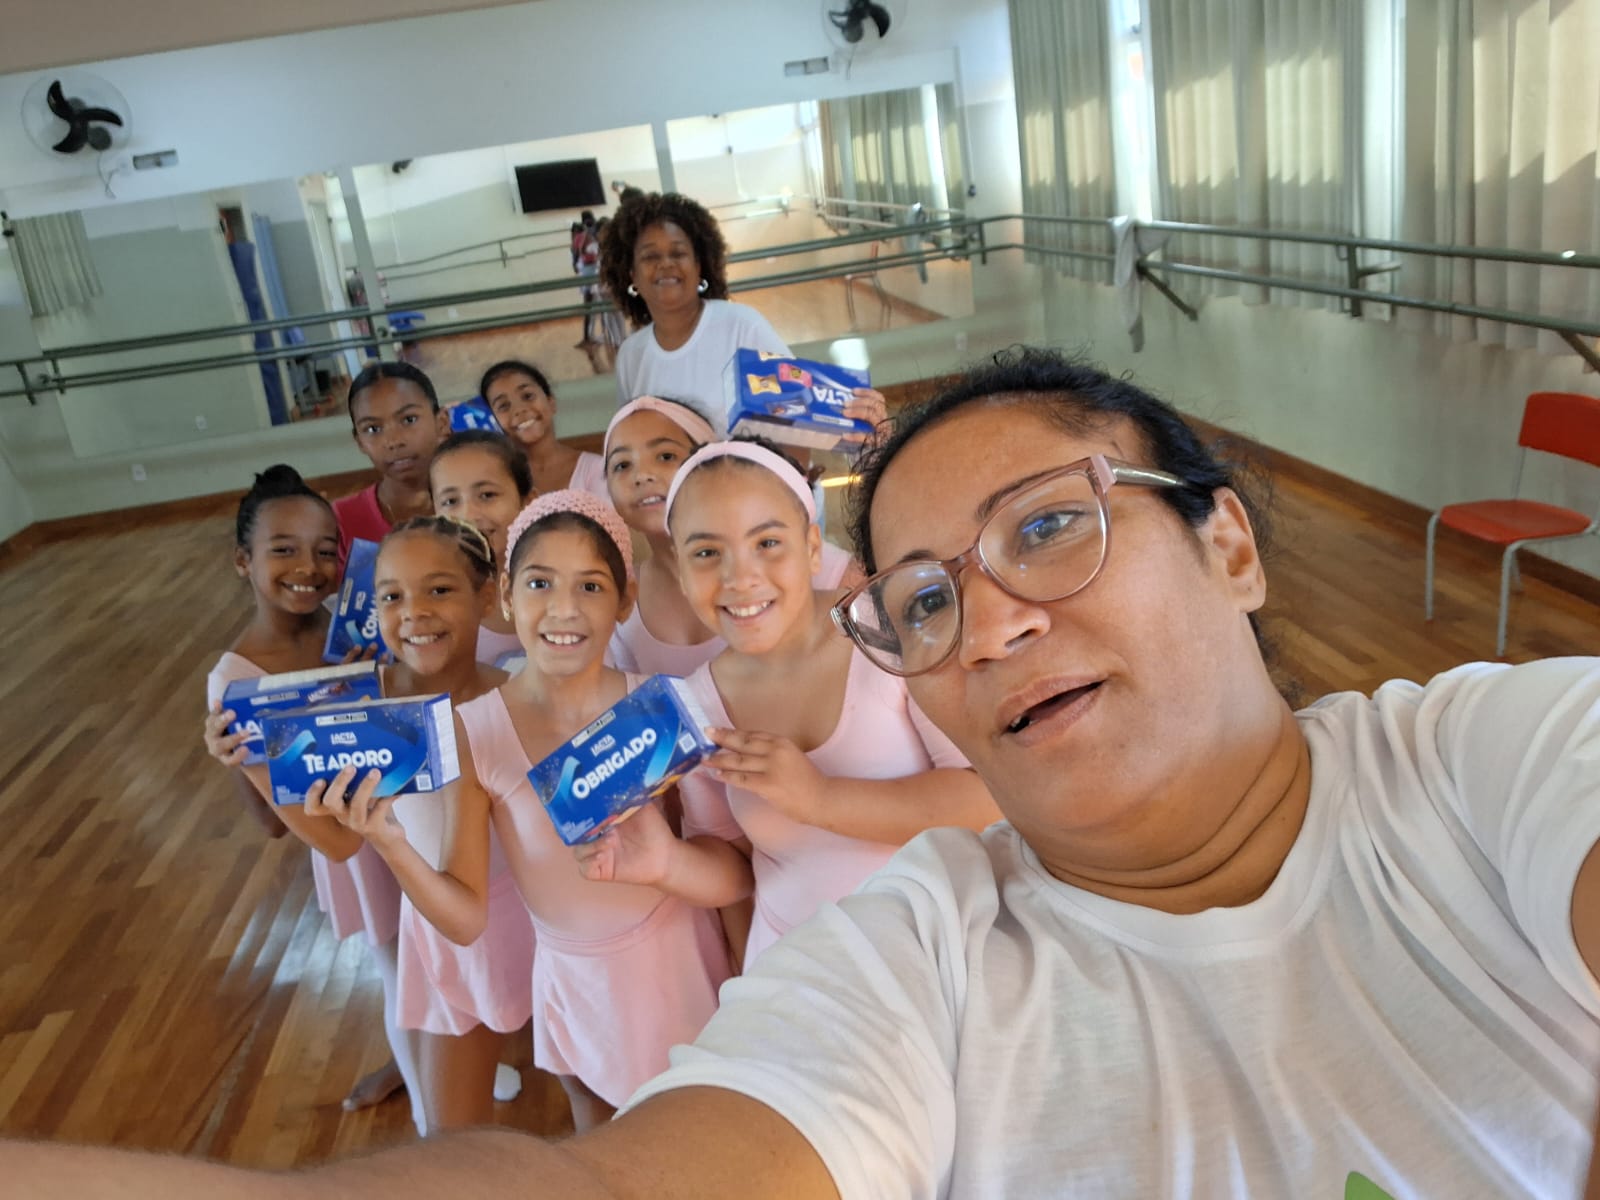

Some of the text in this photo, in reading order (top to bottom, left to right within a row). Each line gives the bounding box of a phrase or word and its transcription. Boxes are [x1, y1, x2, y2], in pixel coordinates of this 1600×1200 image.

[302, 749, 393, 775] TE ADORO
[572, 728, 657, 799] OBRIGADO
